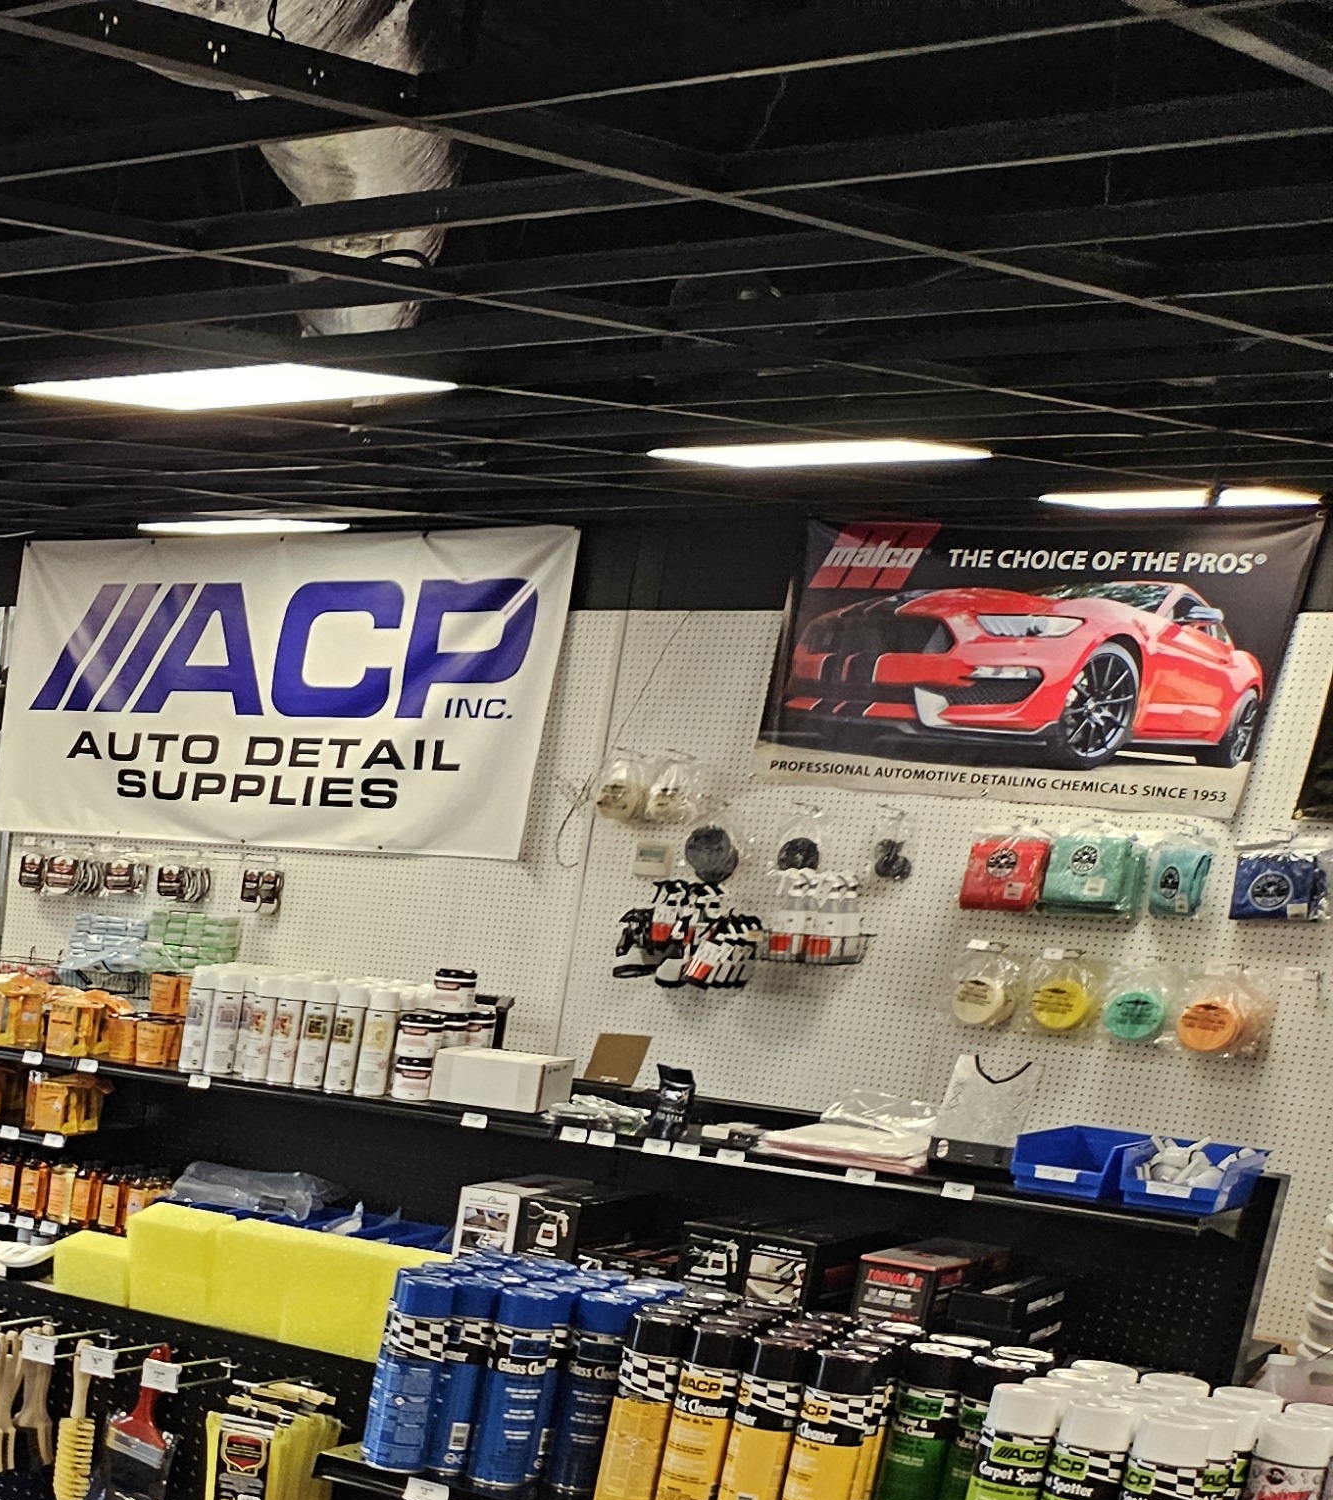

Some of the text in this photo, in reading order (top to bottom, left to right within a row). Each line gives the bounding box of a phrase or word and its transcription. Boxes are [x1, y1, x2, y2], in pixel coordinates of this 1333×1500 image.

[824, 540, 920, 570] malco
[948, 548, 991, 569] THE
[996, 549, 1086, 571] CHOICE
[1090, 550, 1126, 572] OF
[1130, 551, 1179, 573] THE
[444, 697, 514, 721] INC.
[66, 729, 461, 772] AUTO DETAIL
[116, 768, 400, 810] SUPPLIES
[769, 759, 1227, 803] PROFESSIONAL AUTOMOTIVE DETAILING CHEMICALS SINCE 1953
[497, 1357, 527, 1376] Glass
[685, 1378, 721, 1397] ACP
[688, 1398, 729, 1418] Cleaner
[800, 1421, 838, 1445] Cleaner
[1006, 1446, 1046, 1464] ACP
[979, 1461, 1014, 1482] Carpet
[1126, 1471, 1152, 1488] CP
[1052, 1478, 1095, 1498] Spotter
